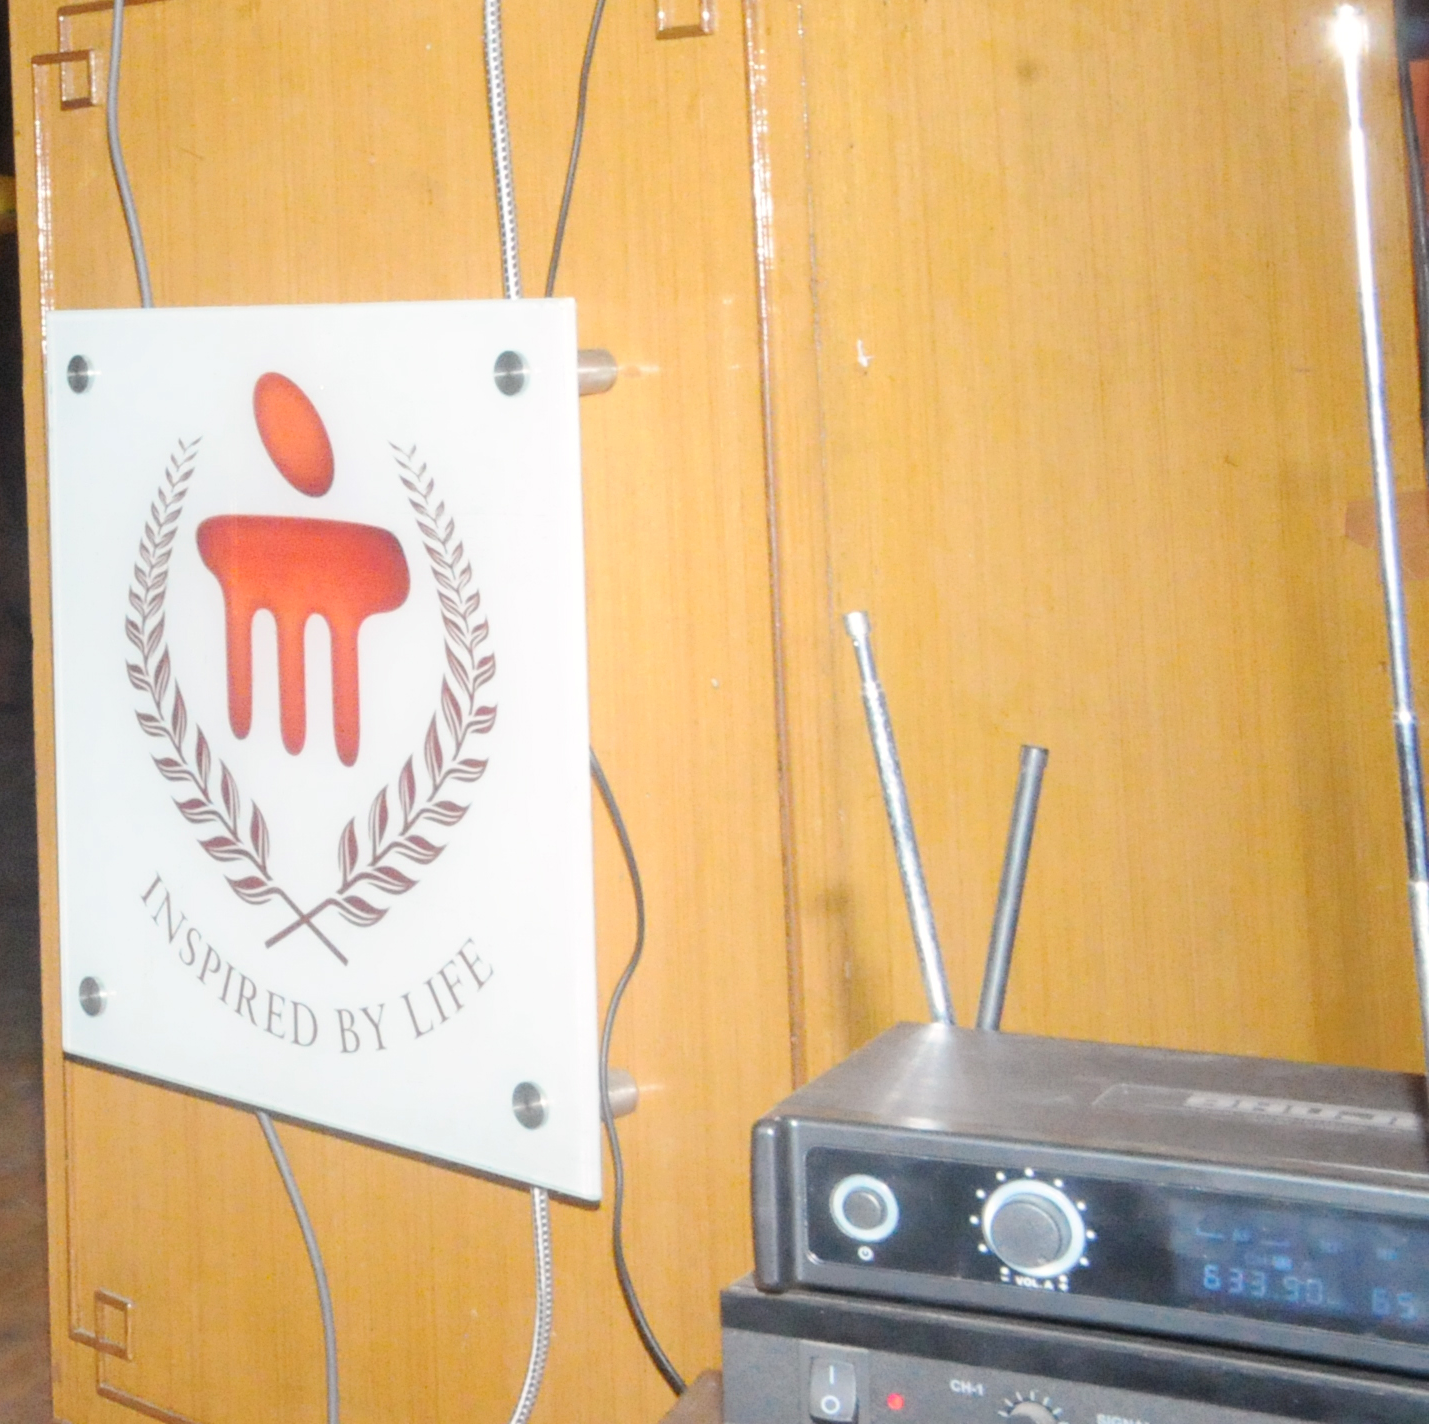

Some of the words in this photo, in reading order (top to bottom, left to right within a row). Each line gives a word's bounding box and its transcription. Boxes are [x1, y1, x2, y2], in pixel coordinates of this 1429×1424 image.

[141, 871, 319, 1049] INSPIRED
[334, 1003, 388, 1054] BY
[400, 937, 495, 1040] LIFE
[949, 1379, 985, 1396] CH-1
